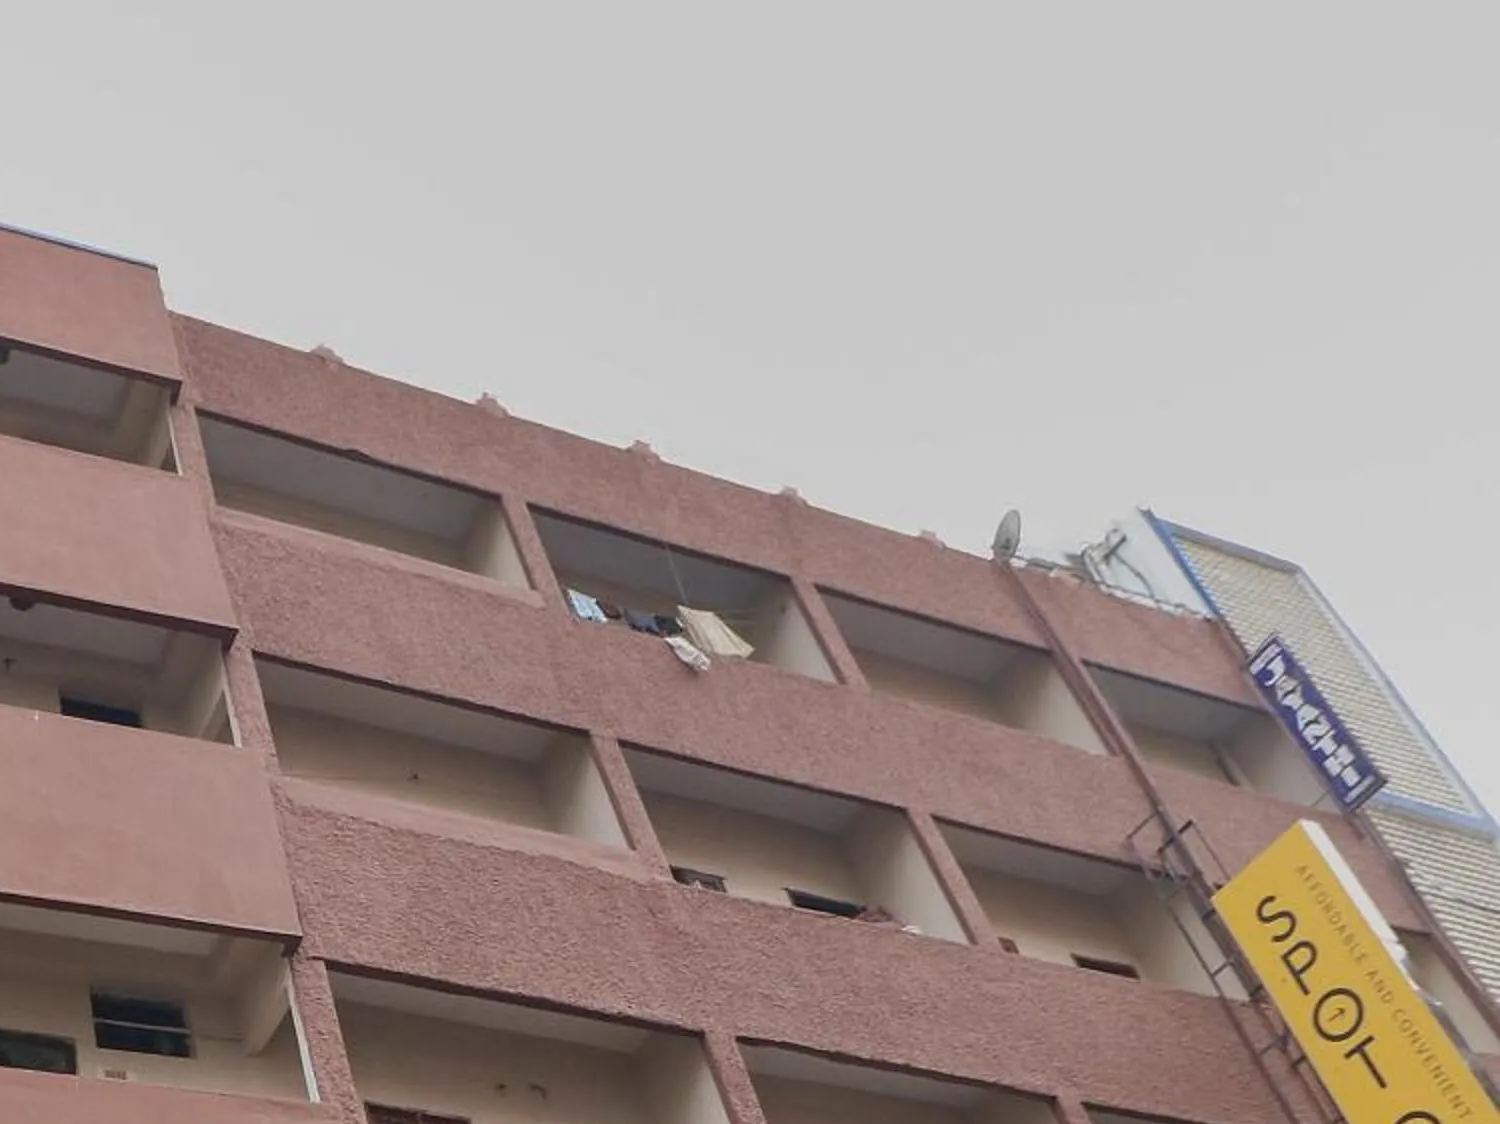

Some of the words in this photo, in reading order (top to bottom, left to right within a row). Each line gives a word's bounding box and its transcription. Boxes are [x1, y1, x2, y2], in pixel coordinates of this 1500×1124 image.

[1255, 893, 1388, 1089] SPOT
[1297, 864, 1368, 965] AFFORDABLE
[1364, 969, 1395, 1007] AND
[1393, 1007, 1474, 1121] CONVENIENT
